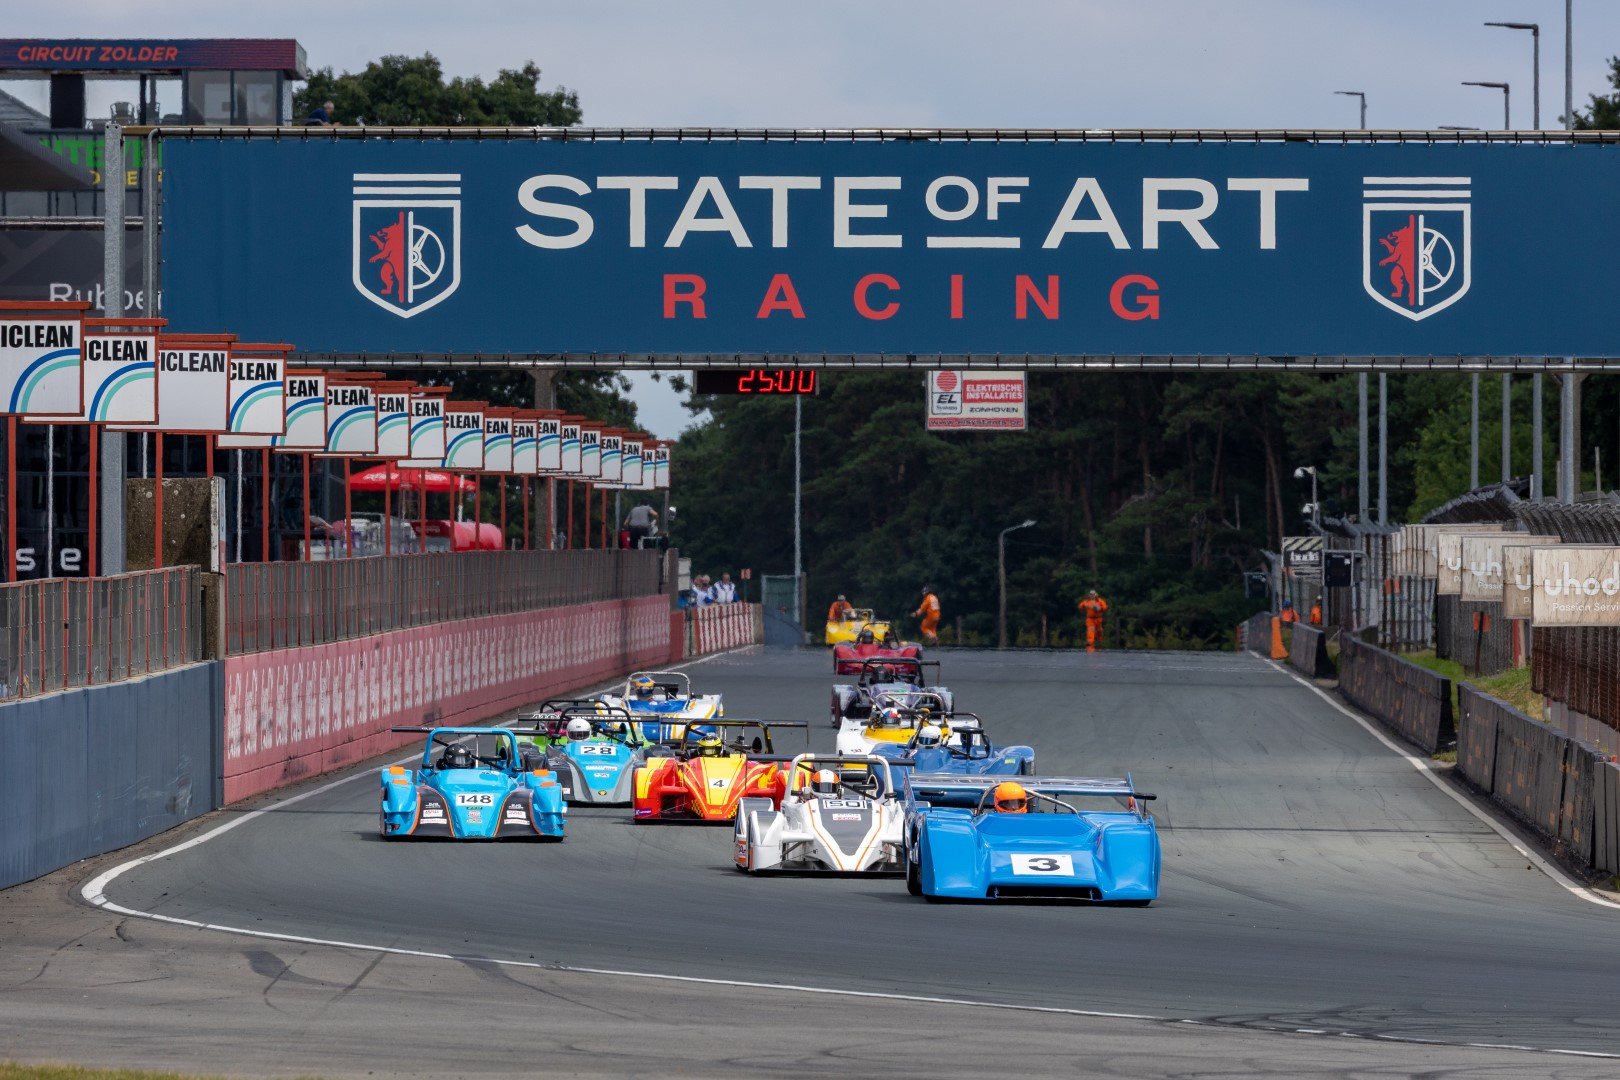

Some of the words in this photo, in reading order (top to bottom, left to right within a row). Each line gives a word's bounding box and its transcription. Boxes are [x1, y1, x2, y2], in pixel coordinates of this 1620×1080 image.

[18, 46, 93, 61] CIRCUIT
[100, 46, 177, 61] ZOLDER
[515, 174, 903, 249] STATE
[925, 175, 1030, 221] OF
[1041, 177, 1309, 250] ART
[663, 273, 1160, 321] RACING
[1, 324, 74, 348] ICLEAN
[160, 352, 225, 373] ICLEAN
[738, 369, 816, 393] 25:00
[966, 384, 1022, 392] ELEKTRISCHE
[937, 394, 957, 404] EL
[966, 391, 1023, 400] INSTALLATIES
[486, 420, 509, 434] EAN
[1544, 561, 1620, 596] uhod
[1553, 603, 1591, 613] Passion
[583, 746, 612, 754] 28
[712, 779, 724, 788] 4
[458, 795, 492, 804] 148
[1028, 857, 1061, 872] 3
